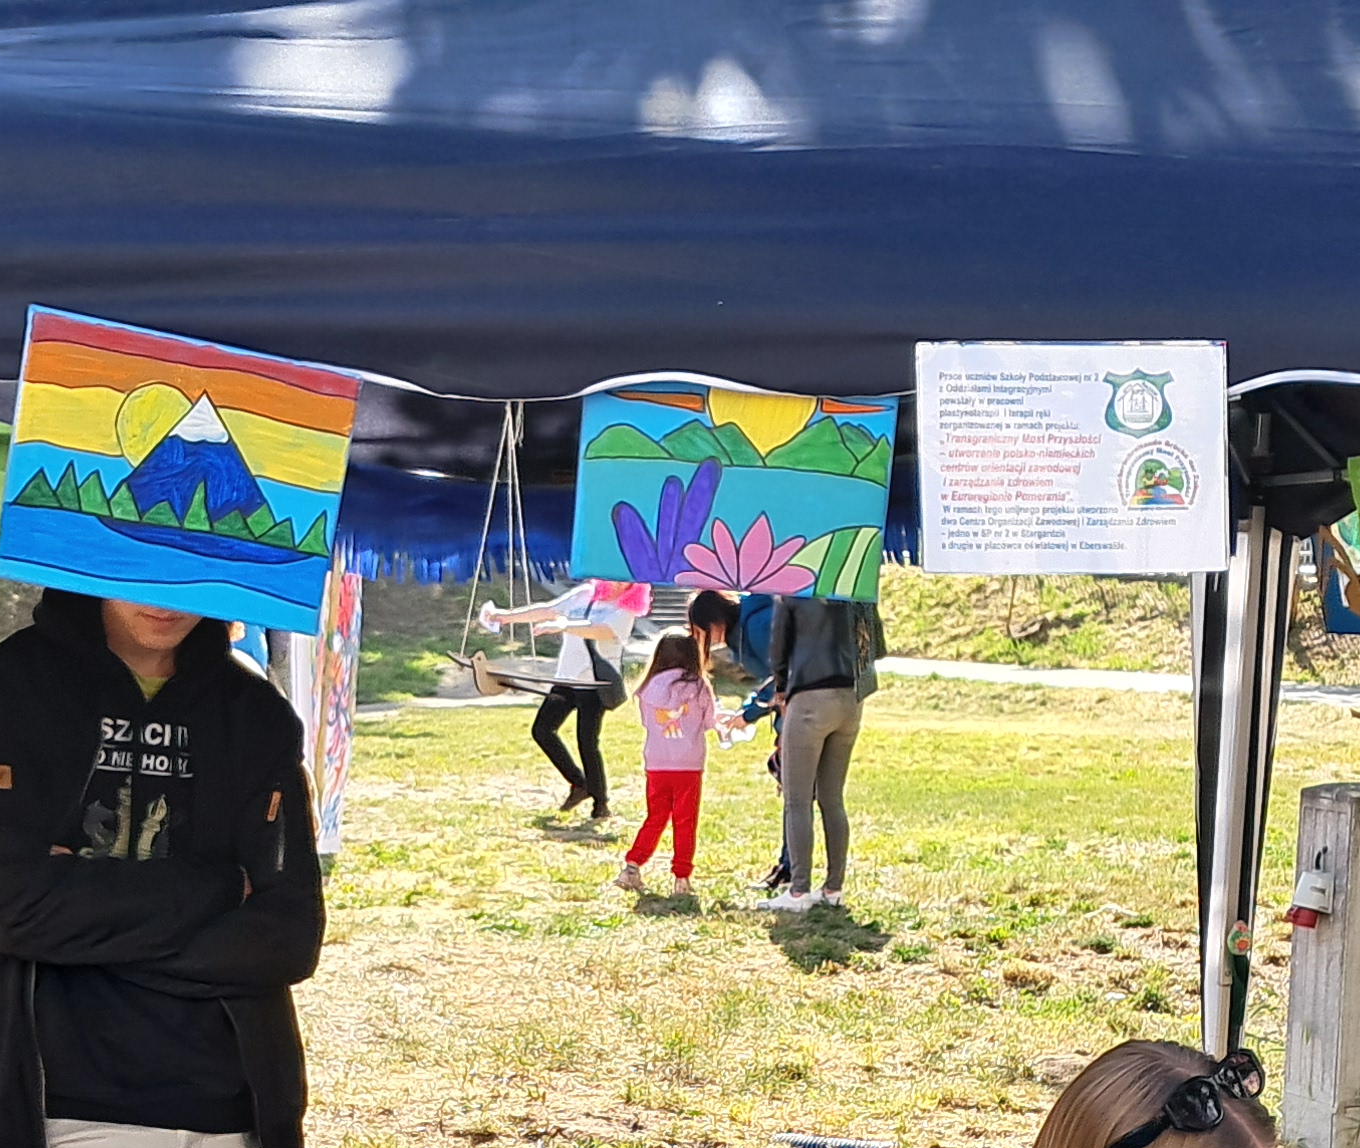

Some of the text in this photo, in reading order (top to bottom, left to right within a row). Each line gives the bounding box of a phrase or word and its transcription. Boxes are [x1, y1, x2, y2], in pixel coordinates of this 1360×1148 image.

[1000, 372, 1026, 382] Szkoły
[1029, 372, 1081, 383] Podstawowej
[1094, 373, 1099, 381] 2
